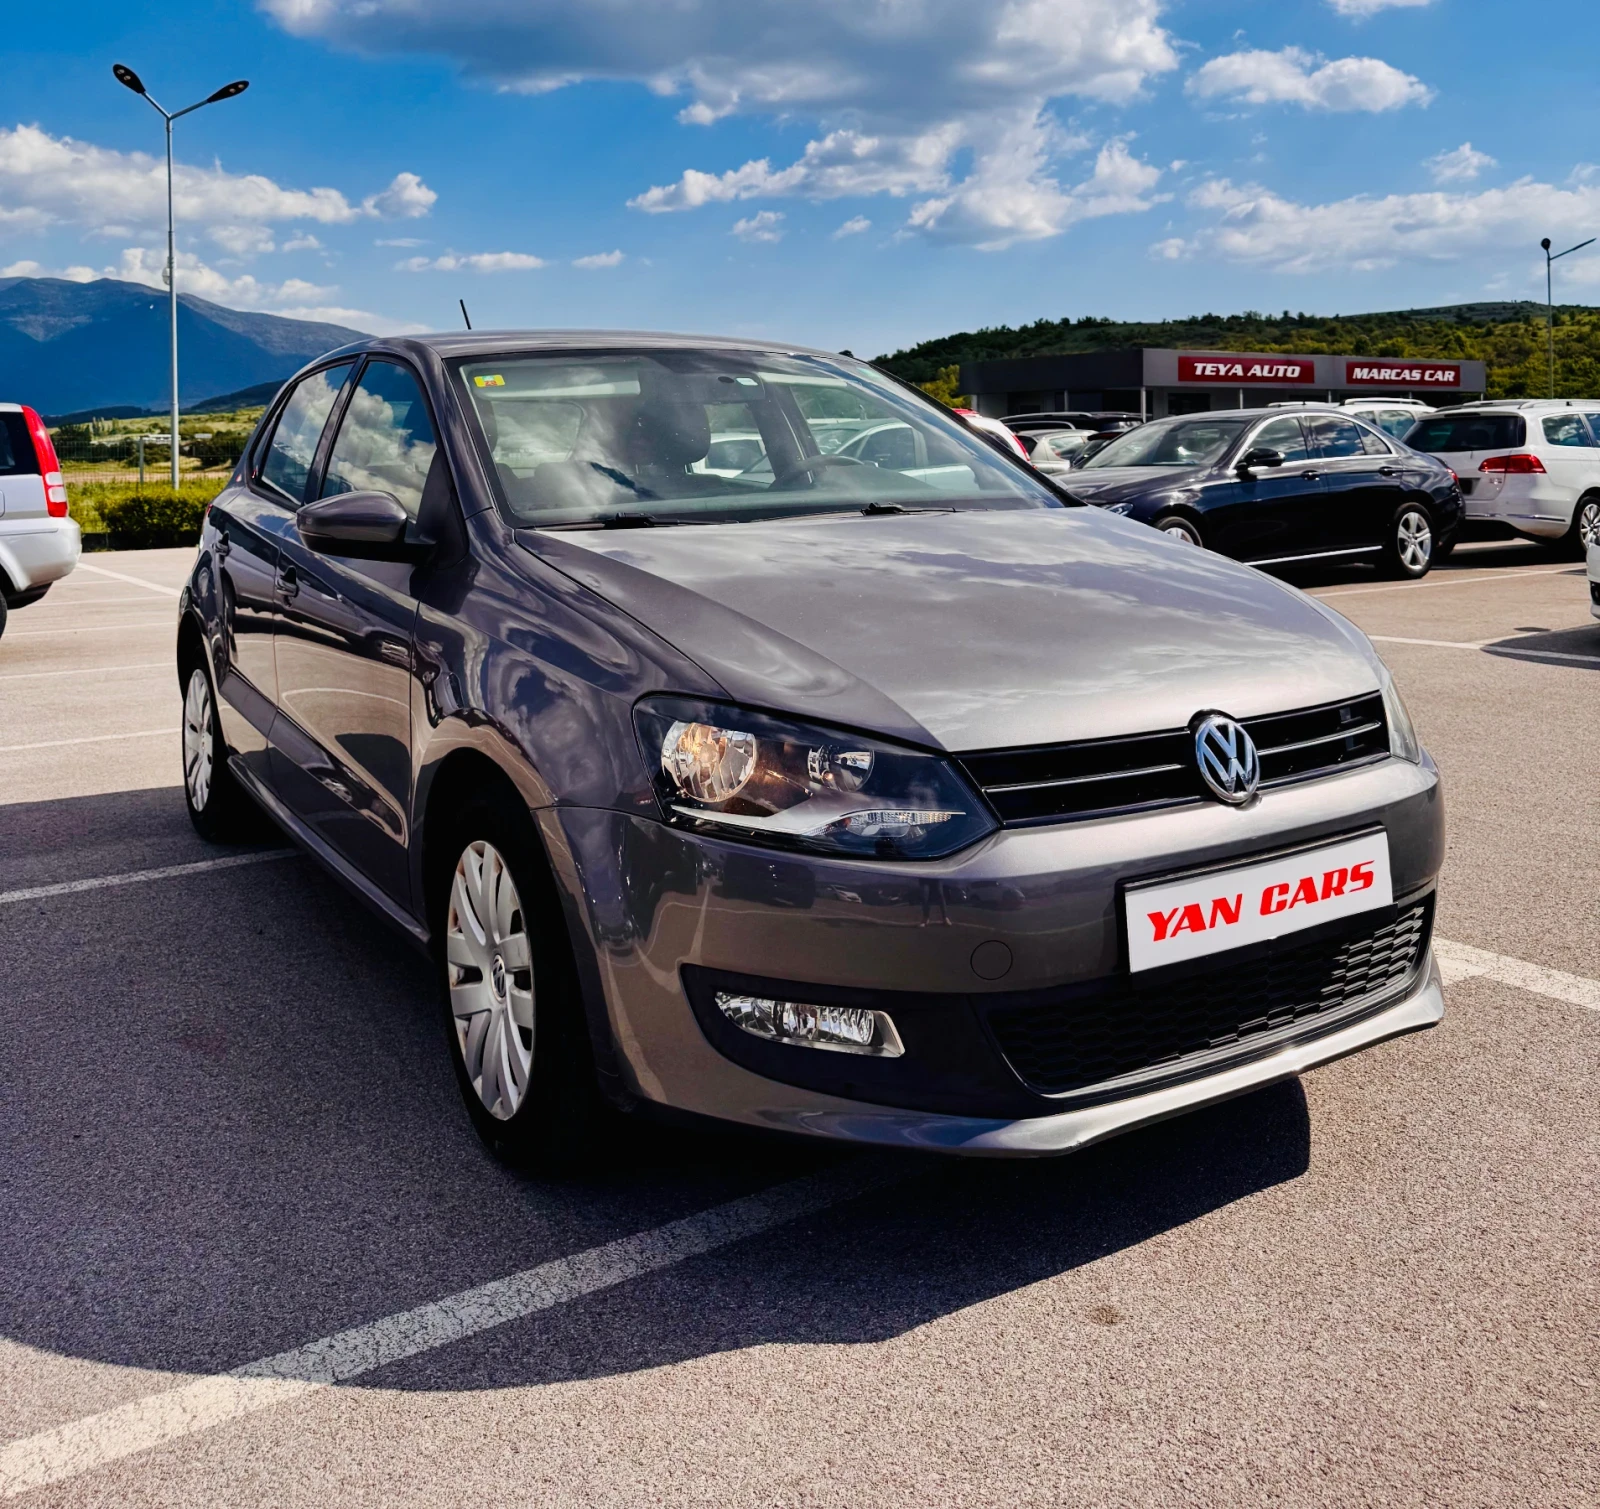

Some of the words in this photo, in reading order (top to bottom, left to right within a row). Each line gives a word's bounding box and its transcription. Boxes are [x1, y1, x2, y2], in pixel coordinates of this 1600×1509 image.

[1194, 362, 1244, 376] TEYA
[1247, 364, 1301, 378] AUTO
[1352, 367, 1422, 380] MARCAS
[1424, 370, 1456, 382] CAR
[1195, 716, 1260, 803] VW
[1147, 893, 1242, 942] YAN
[1259, 860, 1375, 916] CARS
